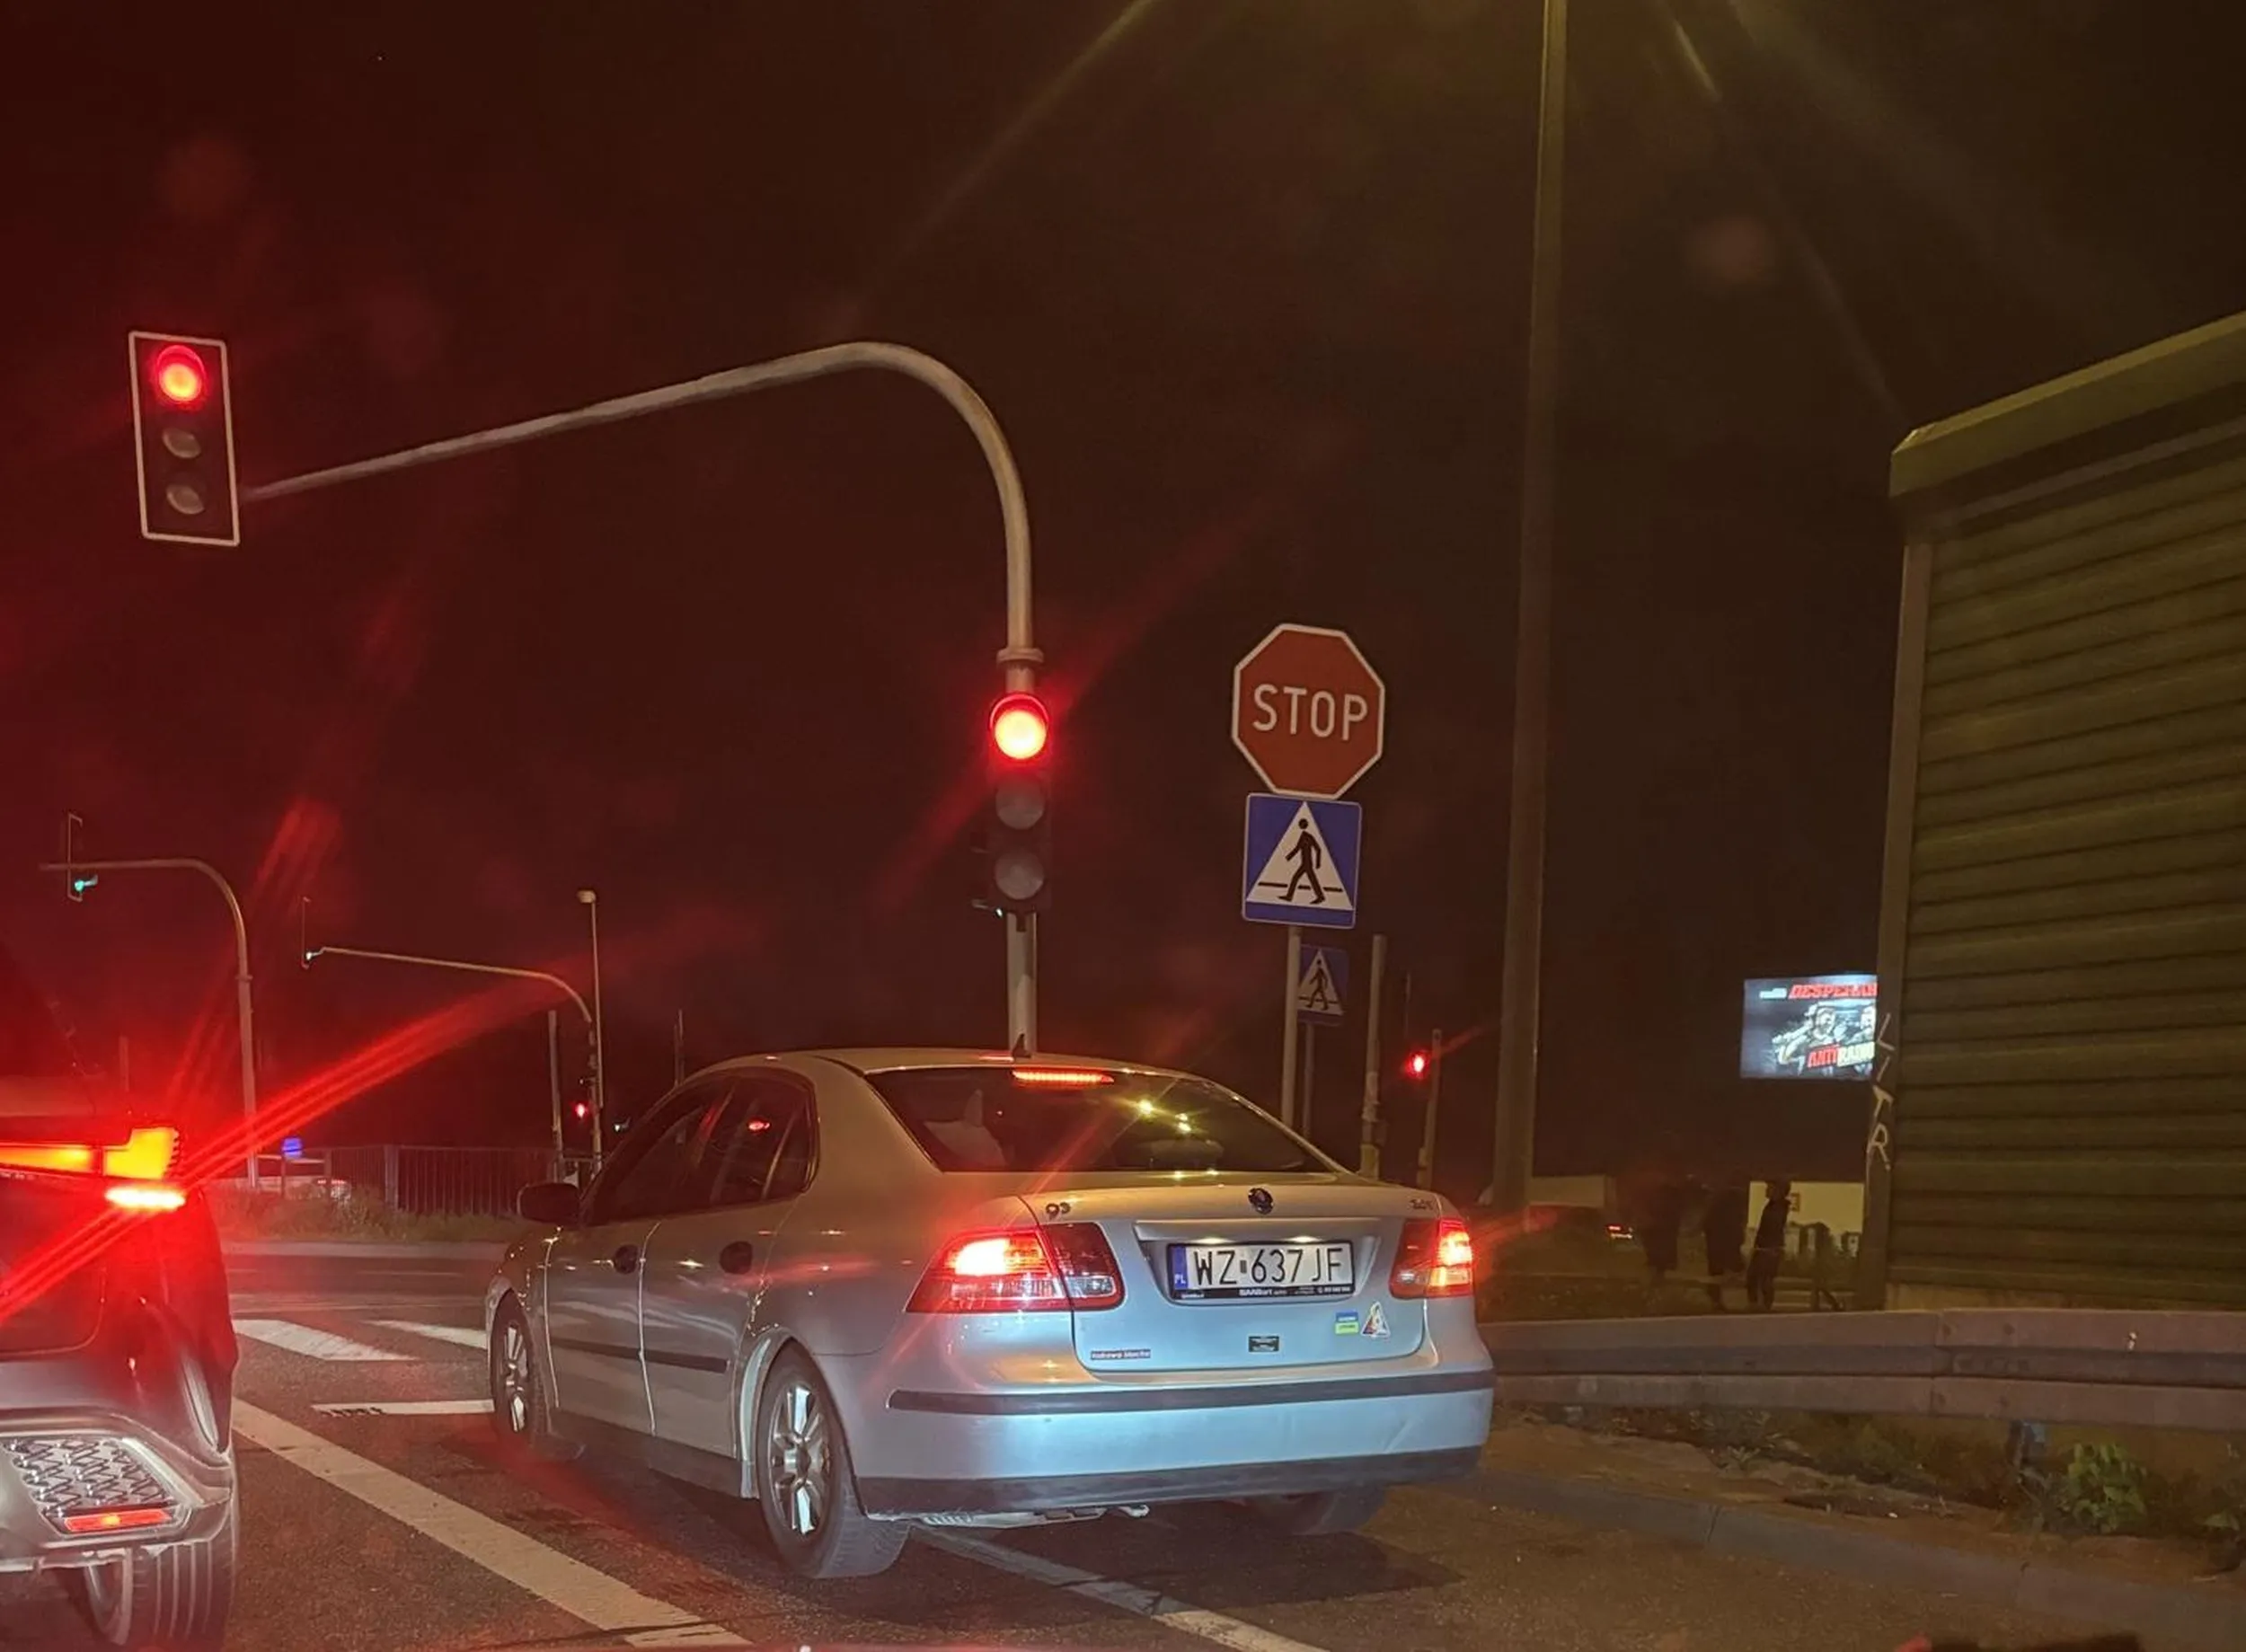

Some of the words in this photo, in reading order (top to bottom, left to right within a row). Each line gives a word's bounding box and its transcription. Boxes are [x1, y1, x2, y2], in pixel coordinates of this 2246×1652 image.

[1252, 684, 1368, 741] STOP
[1174, 1274, 1186, 1285] PL
[1194, 1250, 1237, 1285] WZ
